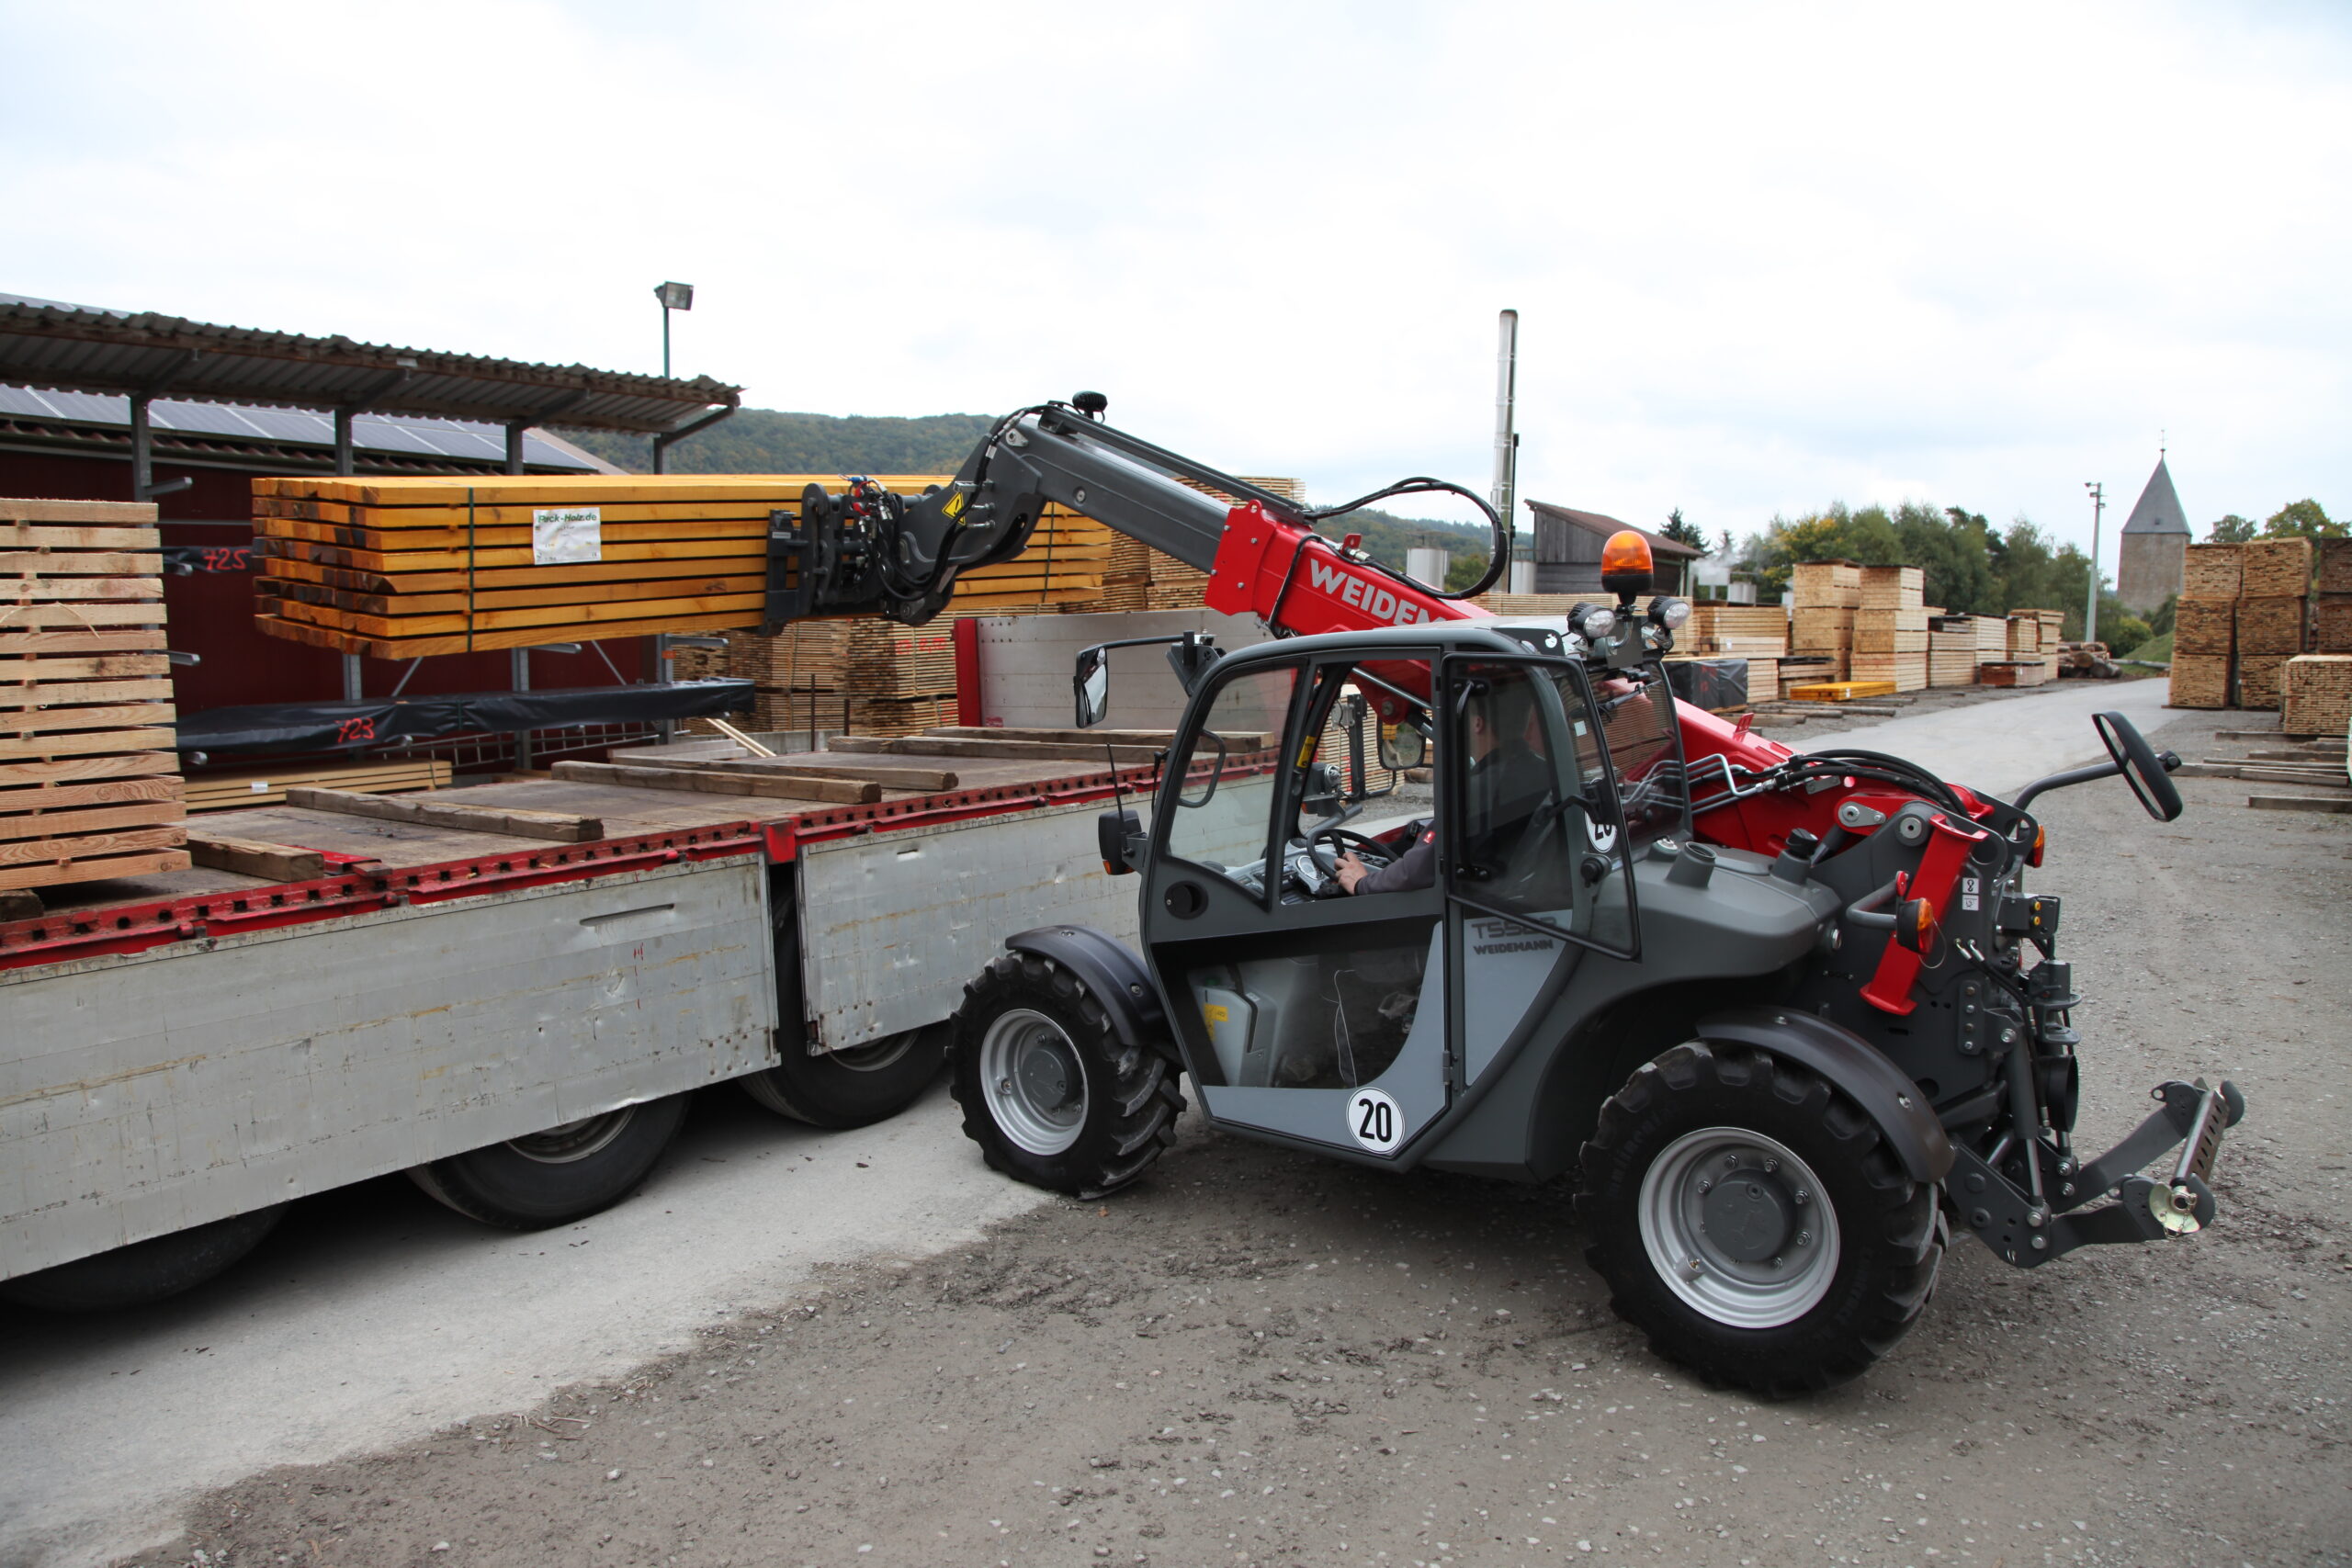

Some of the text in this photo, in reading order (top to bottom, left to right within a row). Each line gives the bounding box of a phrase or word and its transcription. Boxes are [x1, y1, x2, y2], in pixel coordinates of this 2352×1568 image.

[202, 547, 251, 570] 725
[334, 717, 375, 743] 723
[1473, 939, 1554, 955] WEIDEMANN
[1358, 1098, 1393, 1143] 20
